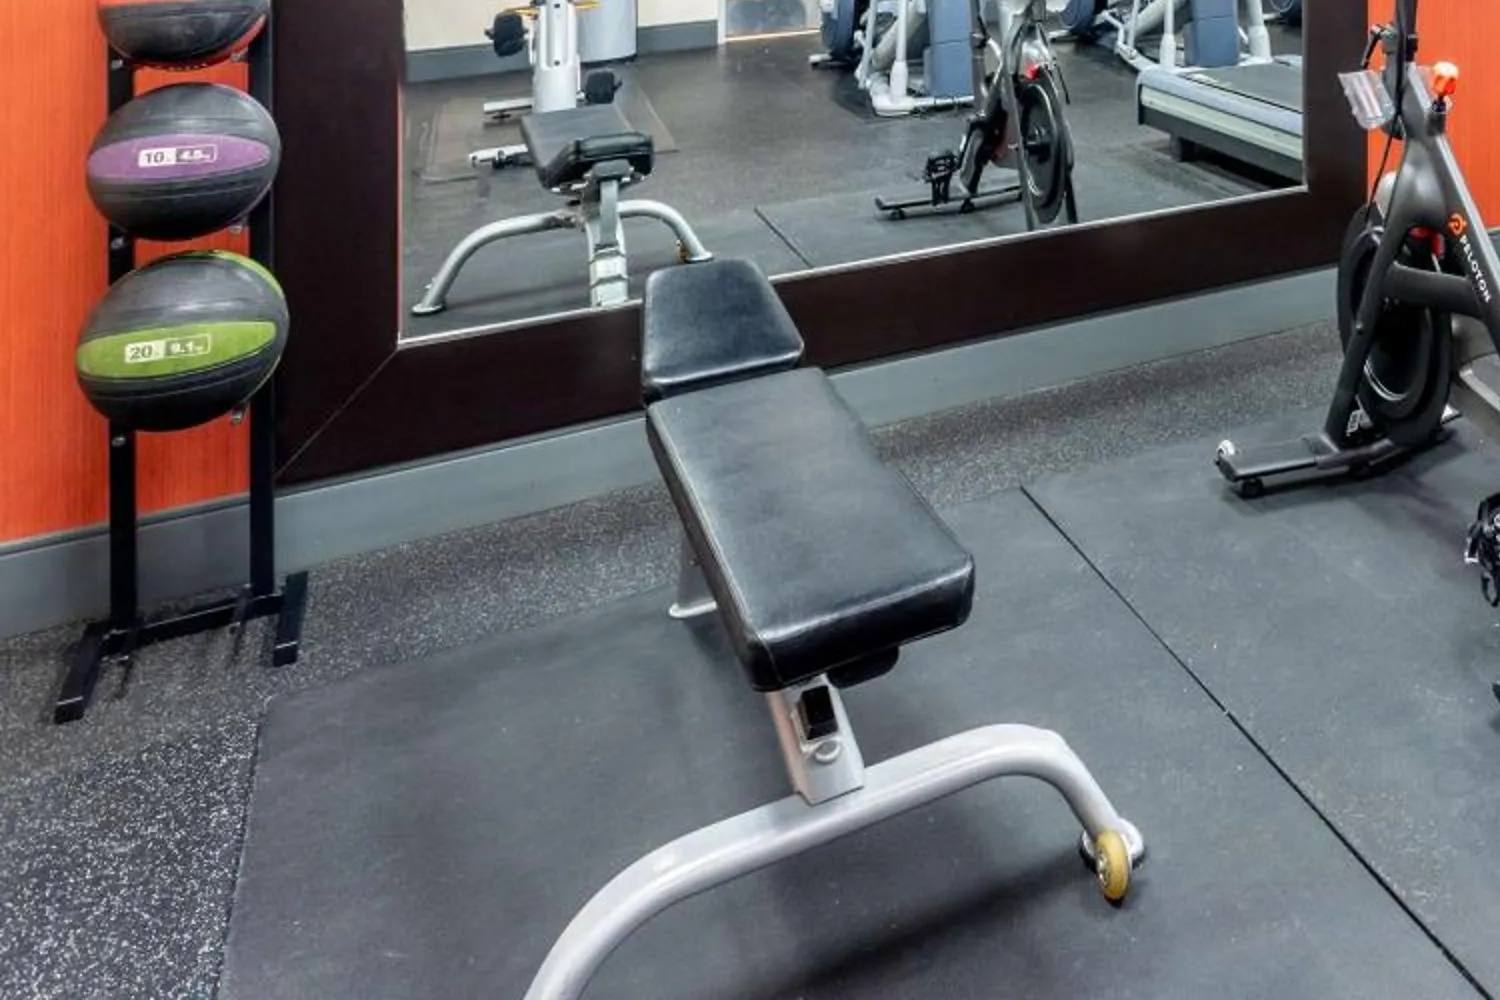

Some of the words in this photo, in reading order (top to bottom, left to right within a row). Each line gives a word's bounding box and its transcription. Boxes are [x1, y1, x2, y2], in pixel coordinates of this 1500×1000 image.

[145, 151, 164, 164] 10
[1459, 234, 1491, 303] PELOTON
[130, 344, 153, 360] 20
